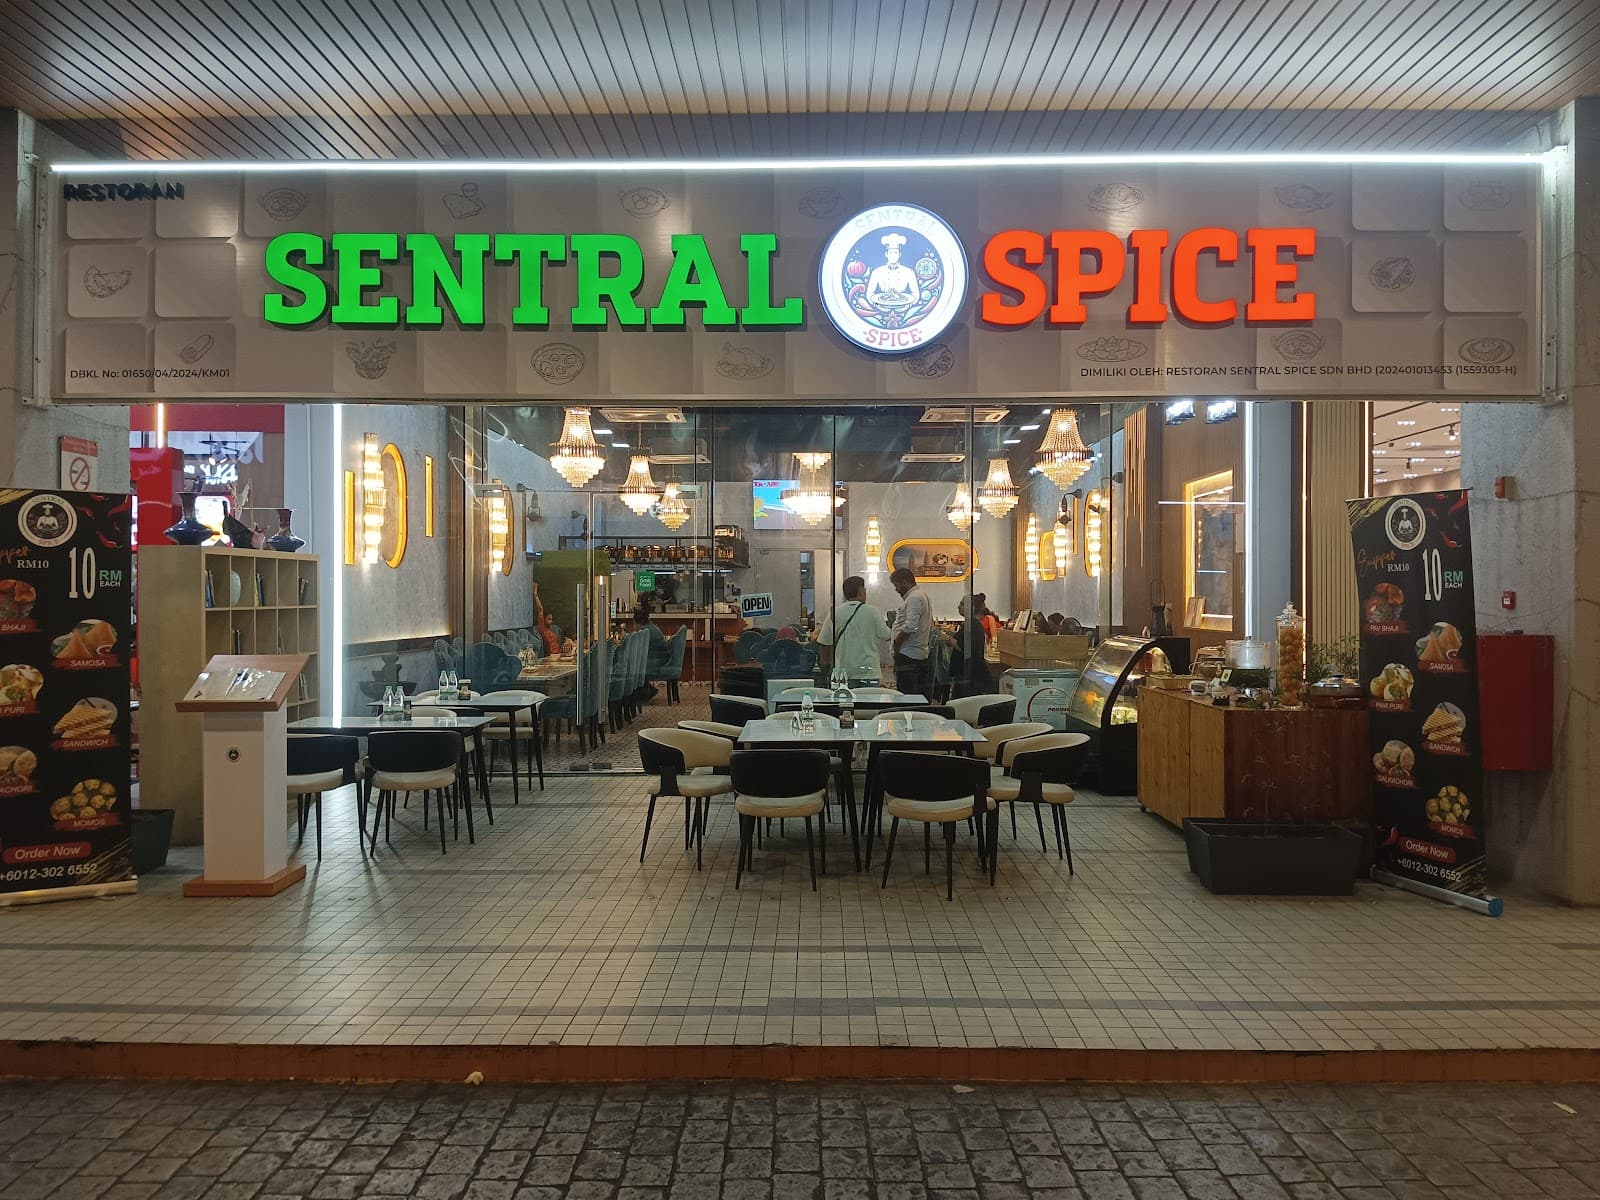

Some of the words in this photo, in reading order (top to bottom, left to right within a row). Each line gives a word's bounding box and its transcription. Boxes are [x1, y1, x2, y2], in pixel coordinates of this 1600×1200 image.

[63, 182, 185, 201] RESTORAN
[264, 232, 803, 326] SENTRAL
[982, 227, 1316, 326] SPICE
[70, 369, 99, 379] DBKL
[102, 369, 119, 379] No:
[121, 368, 230, 379] 01650/04/2024/KM01
[1080, 367, 1126, 377] DIMILIKI
[1129, 367, 1164, 377] OLEH:
[1166, 366, 1227, 376] RESTORAN
[1229, 366, 1281, 376] SENTRAL
[1284, 366, 1319, 375] SPICE
[1320, 365, 1343, 375] SDN
[1347, 365, 1372, 375] BHD
[16, 559, 49, 568] RM10
[1387, 563, 1410, 573] RM10
[69, 546, 96, 599] 10
[99, 570, 122, 581] RM
[1422, 548, 1443, 602] 10
[1444, 570, 1463, 582] RM
[743, 597, 770, 611] OPEN
[70, 659, 106, 667] SAMOSA
[1429, 663, 1454, 671] SAMOSA
[3, 706, 25, 714] PURI
[63, 739, 109, 748] SANDWICH
[73, 818, 106, 827] MOMOS
[15, 848, 50, 860] Order
[53, 845, 81, 857] Now
[1405, 840, 1428, 854] Order
[1429, 846, 1449, 859] Now
[0, 865, 64, 882] +6012-302
[67, 863, 98, 876] 6552
[1397, 857, 1439, 876] +6012-302
[1439, 868, 1462, 882] 6552
